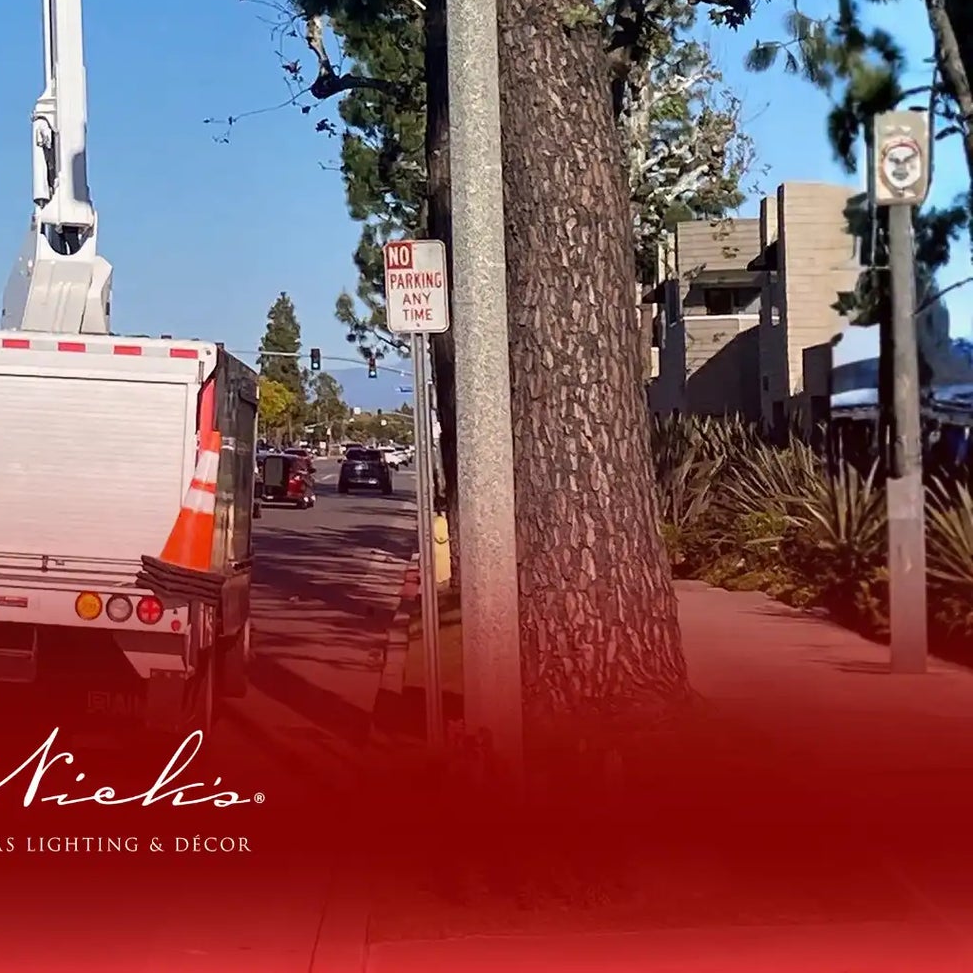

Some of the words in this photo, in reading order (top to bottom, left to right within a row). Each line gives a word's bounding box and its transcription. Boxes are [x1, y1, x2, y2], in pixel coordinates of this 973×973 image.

[388, 245, 410, 266] NO
[390, 272, 442, 289] PARKING
[402, 292, 431, 305] ANY
[402, 308, 433, 321] TIME
